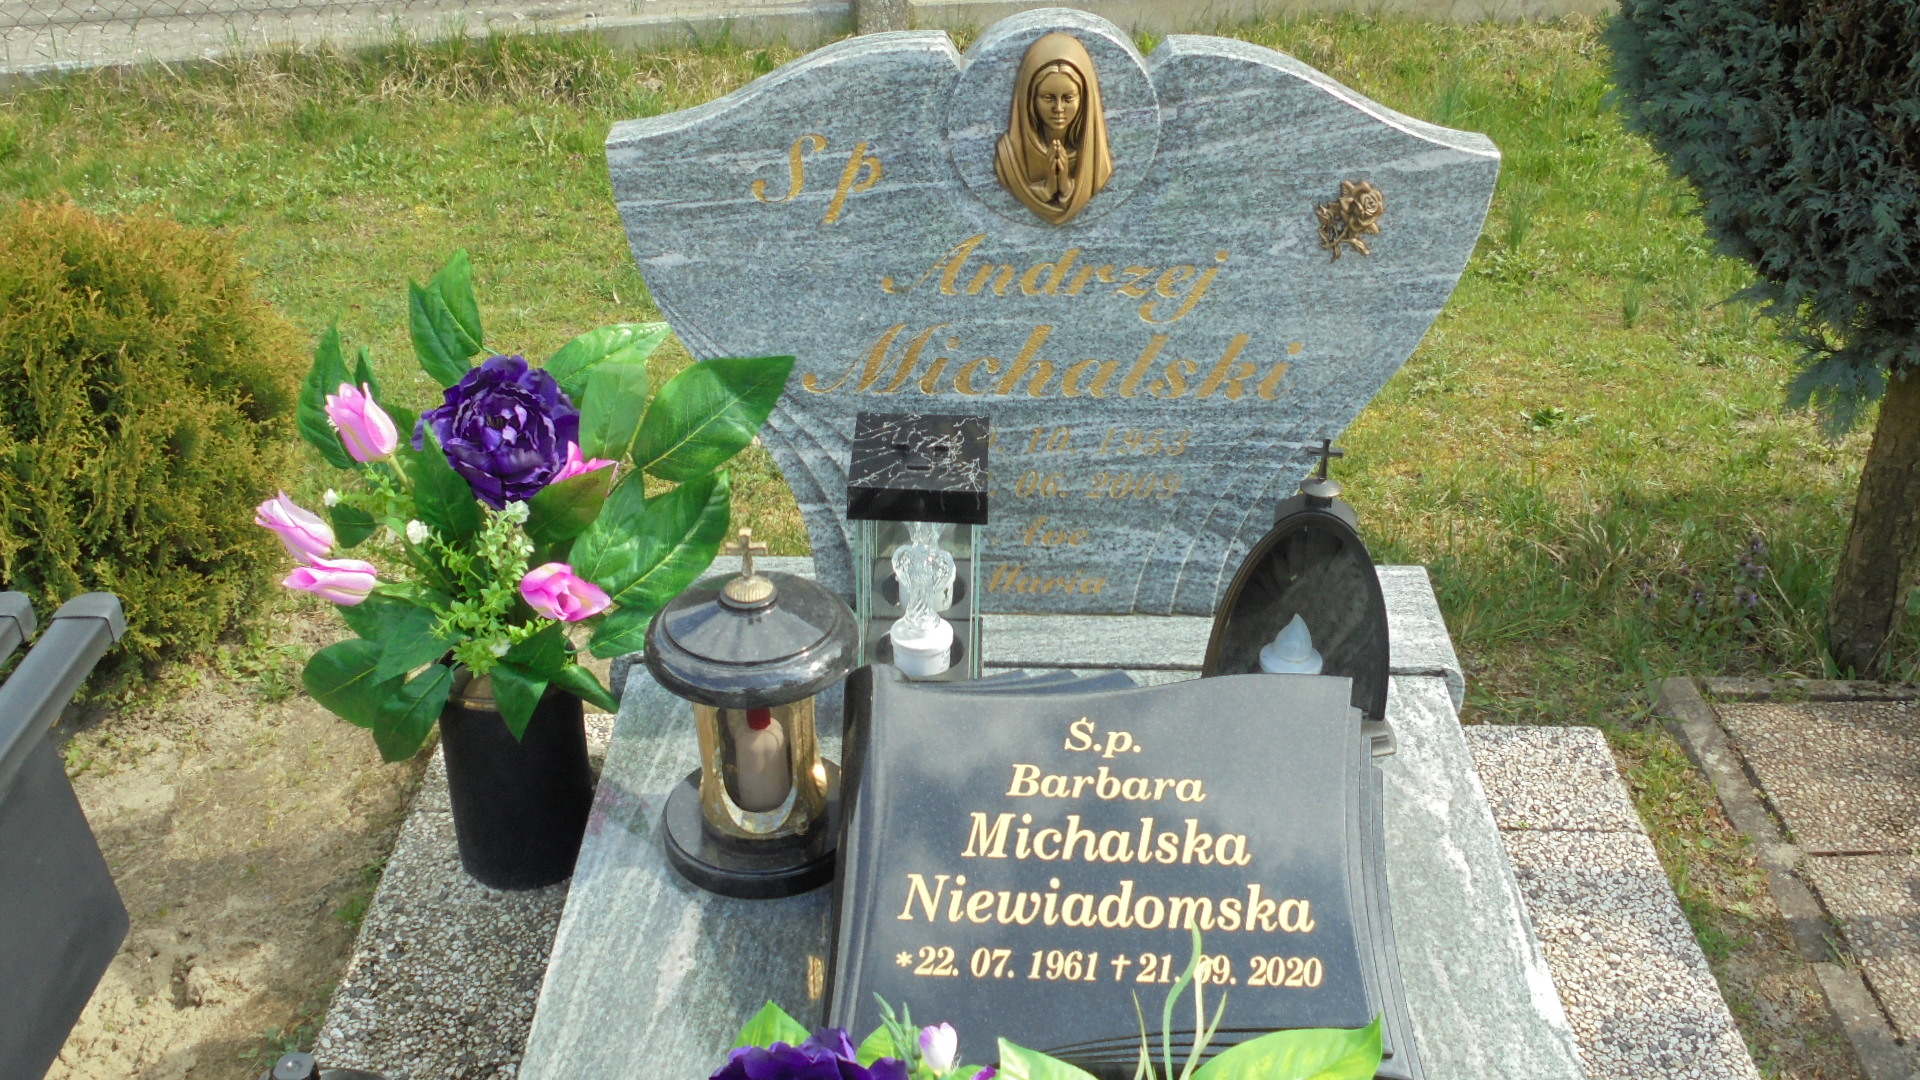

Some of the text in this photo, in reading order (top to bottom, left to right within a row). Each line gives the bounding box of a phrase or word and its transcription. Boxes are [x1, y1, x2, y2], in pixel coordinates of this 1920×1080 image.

[881, 232, 1230, 325] Andrzej
[801, 322, 1305, 401] Michalski
[1099, 427, 1193, 456] 1953
[1015, 470, 1068, 498] 06.
[1085, 471, 1183, 499] 2009
[985, 562, 1107, 595] Maria
[1005, 763, 1207, 803] Barbara
[960, 811, 1253, 867] Michalska
[897, 873, 1316, 933] Niewiadomska
[970, 947, 1015, 979] 07.
[1027, 949, 1099, 981] 1961
[1136, 952, 1181, 983] 21.
[1247, 955, 1323, 987] 2020
